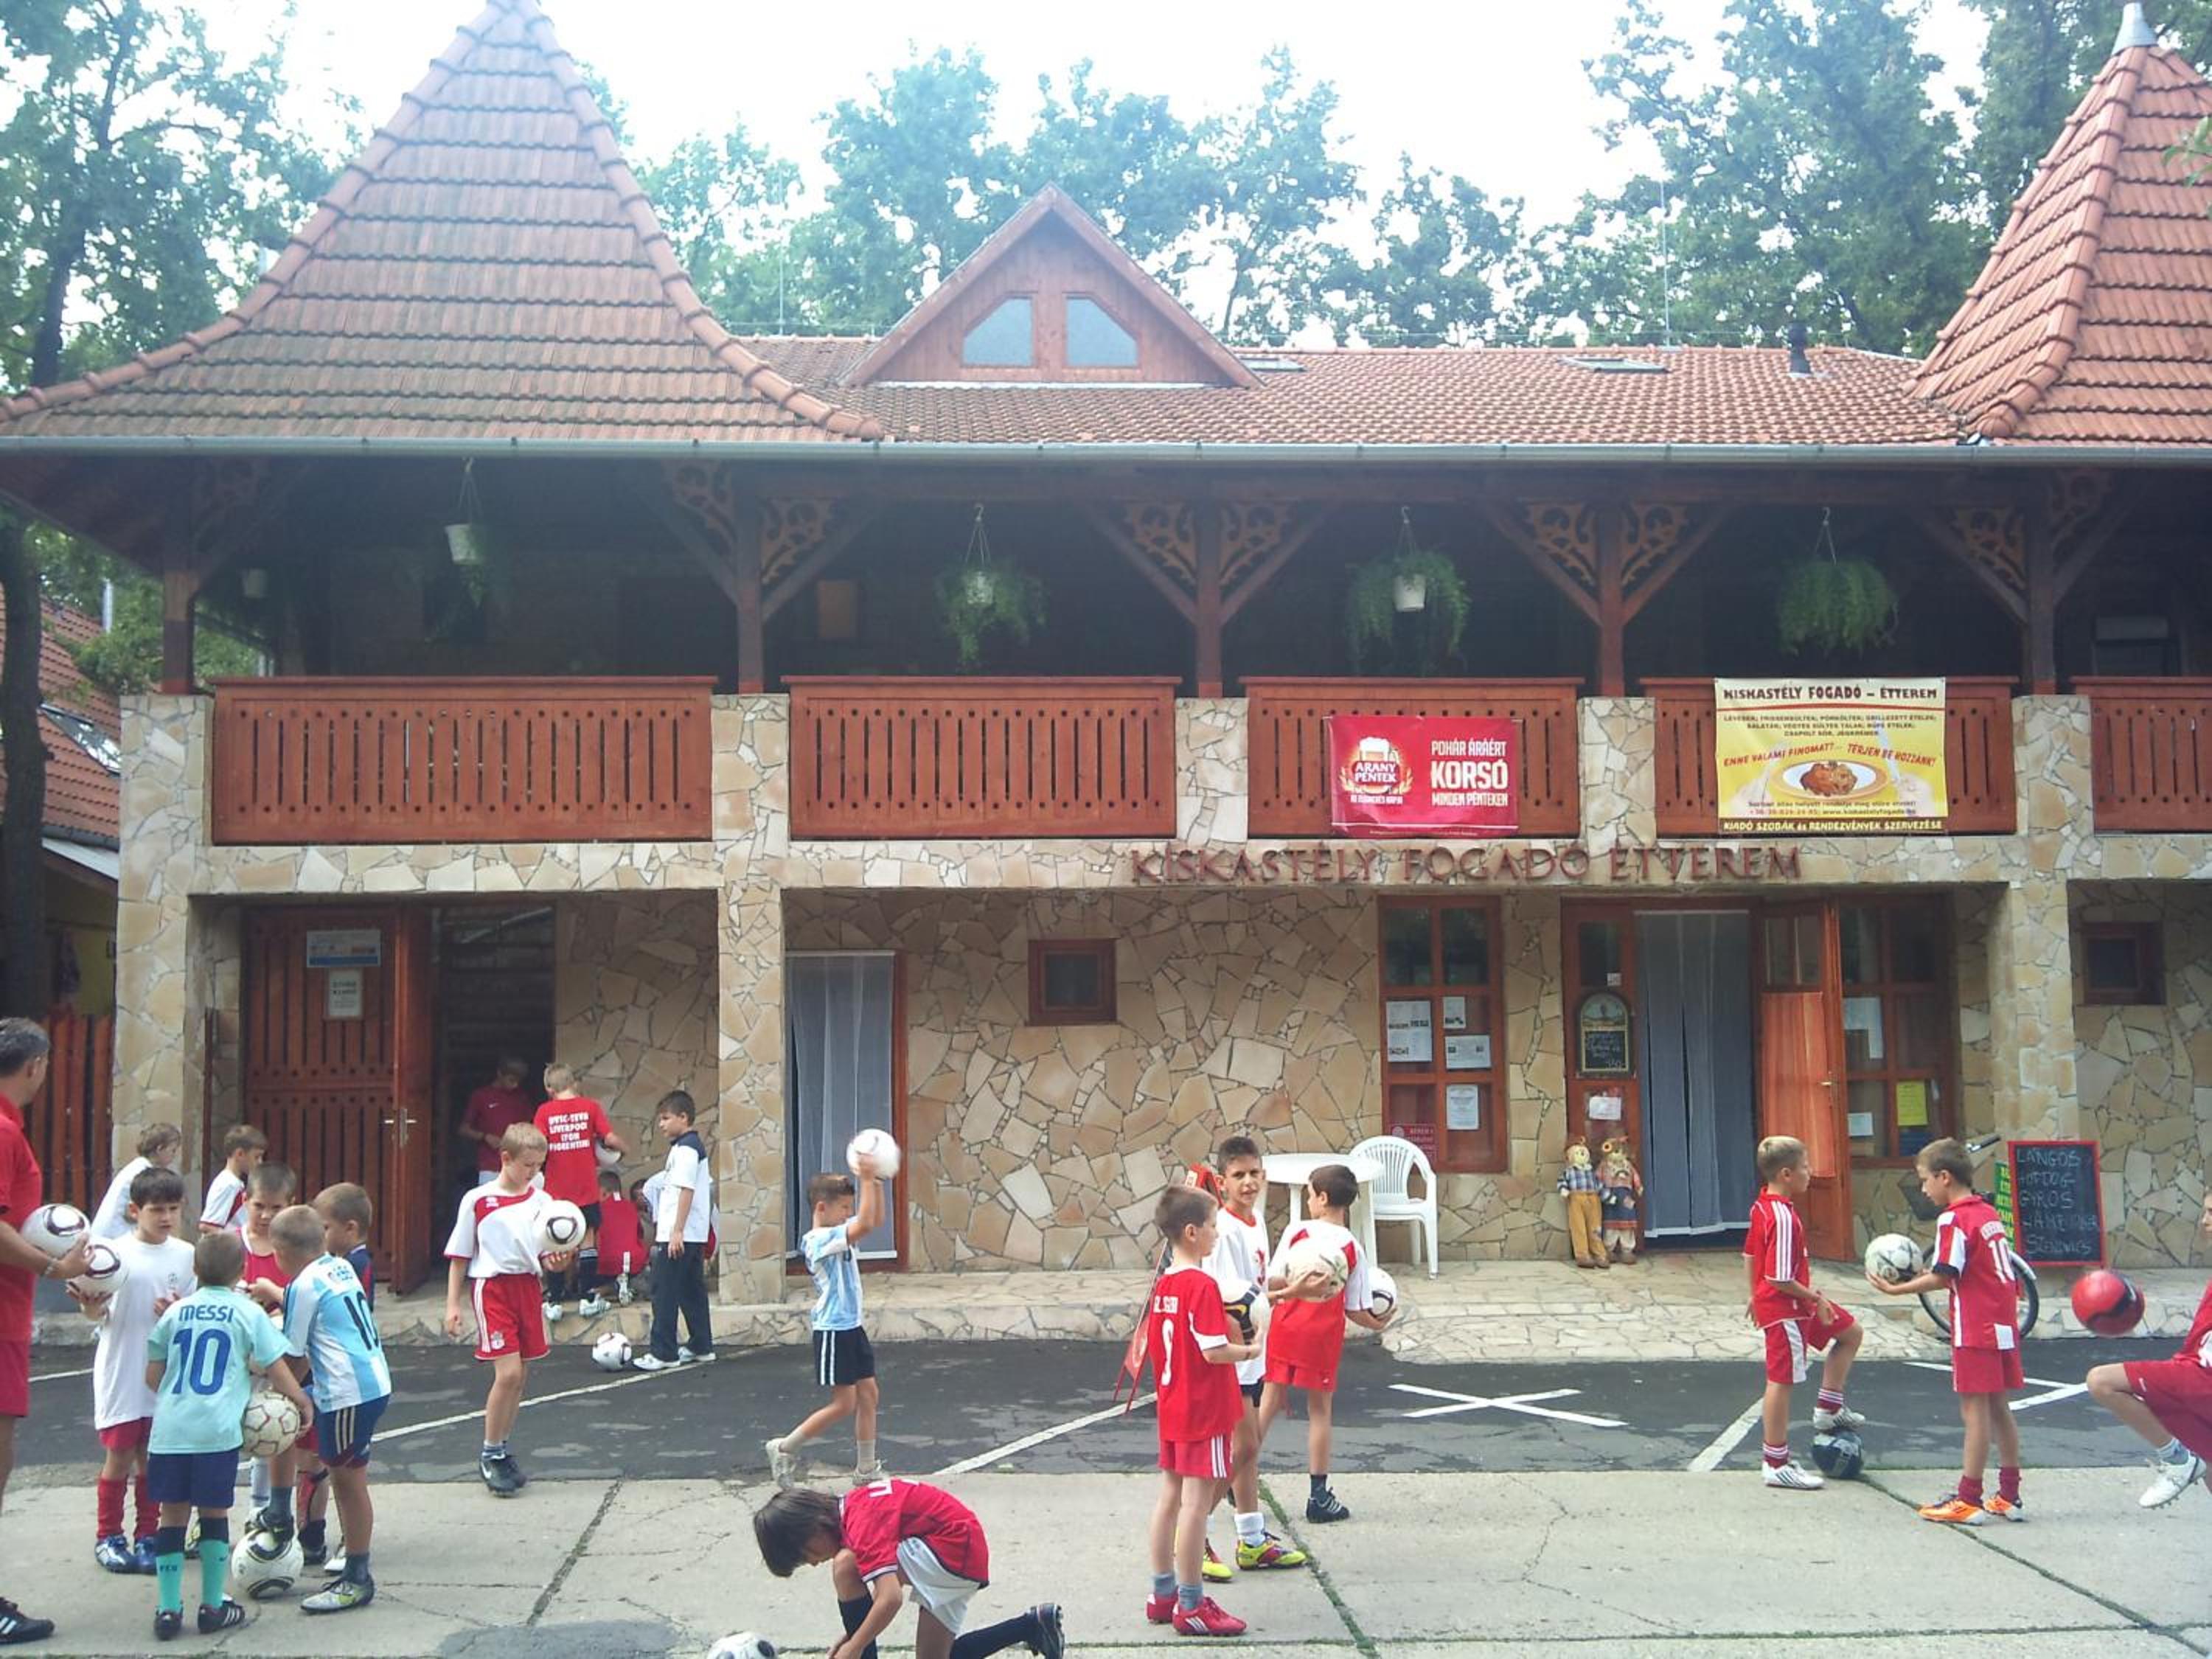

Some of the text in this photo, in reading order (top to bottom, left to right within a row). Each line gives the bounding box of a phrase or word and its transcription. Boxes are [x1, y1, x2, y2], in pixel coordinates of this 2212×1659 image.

[1724, 684, 1802, 700] KISKASTÉLY
[1809, 684, 1861, 699] FOGADÓ
[1880, 684, 1937, 699] ÉTTEREM
[1431, 737, 1507, 756] POHÁR ÁRÁÉRT
[1752, 751, 1785, 762] VALAMI
[1356, 762, 1396, 773] ARANY
[1430, 759, 1509, 790] KORSÓ
[1432, 792, 1509, 807] MINDEN PÉNTEKEN
[1723, 820, 1753, 831] KIADÓ
[1756, 819, 1794, 831] SZOBÁK
[1809, 819, 1880, 831] RENDEZVÉNYEK
[1885, 819, 1943, 830] SZERVEZÉSE
[178, 1304, 234, 1324] MESSI
[172, 1327, 232, 1395] 10
